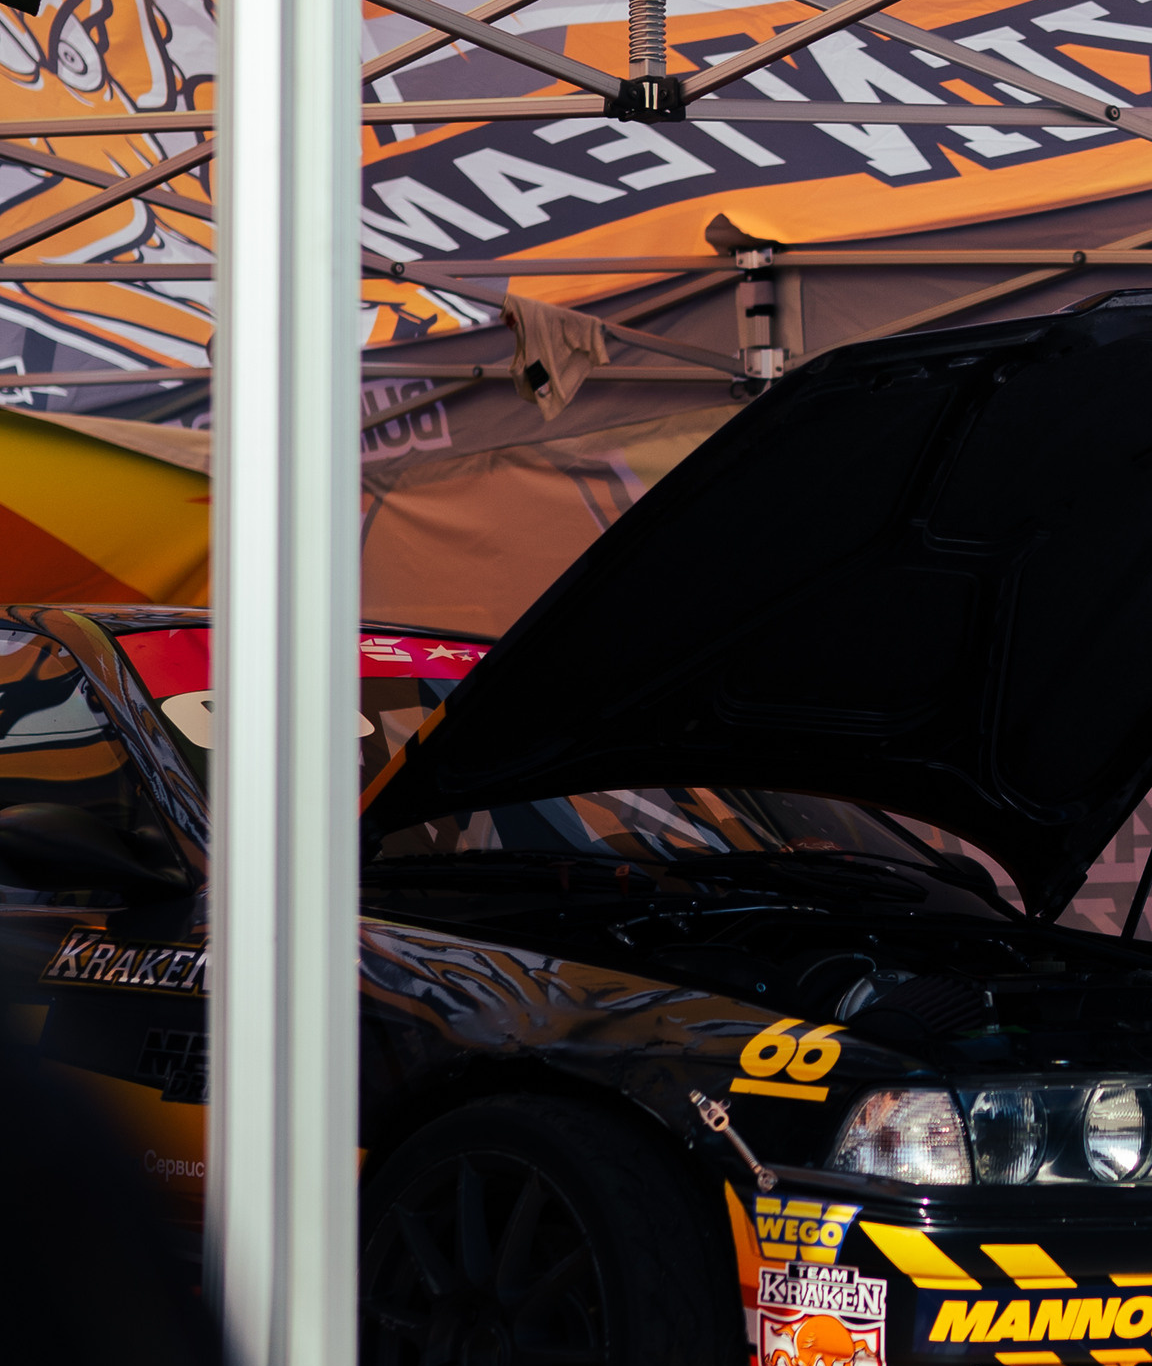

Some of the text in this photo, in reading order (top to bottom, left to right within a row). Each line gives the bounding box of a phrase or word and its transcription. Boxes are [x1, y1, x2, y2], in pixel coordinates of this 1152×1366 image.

[740, 1018, 849, 1082] 66
[756, 1216, 843, 1247] WEGO
[796, 1266, 848, 1283] TEAM
[762, 1273, 881, 1315] KRAKEN
